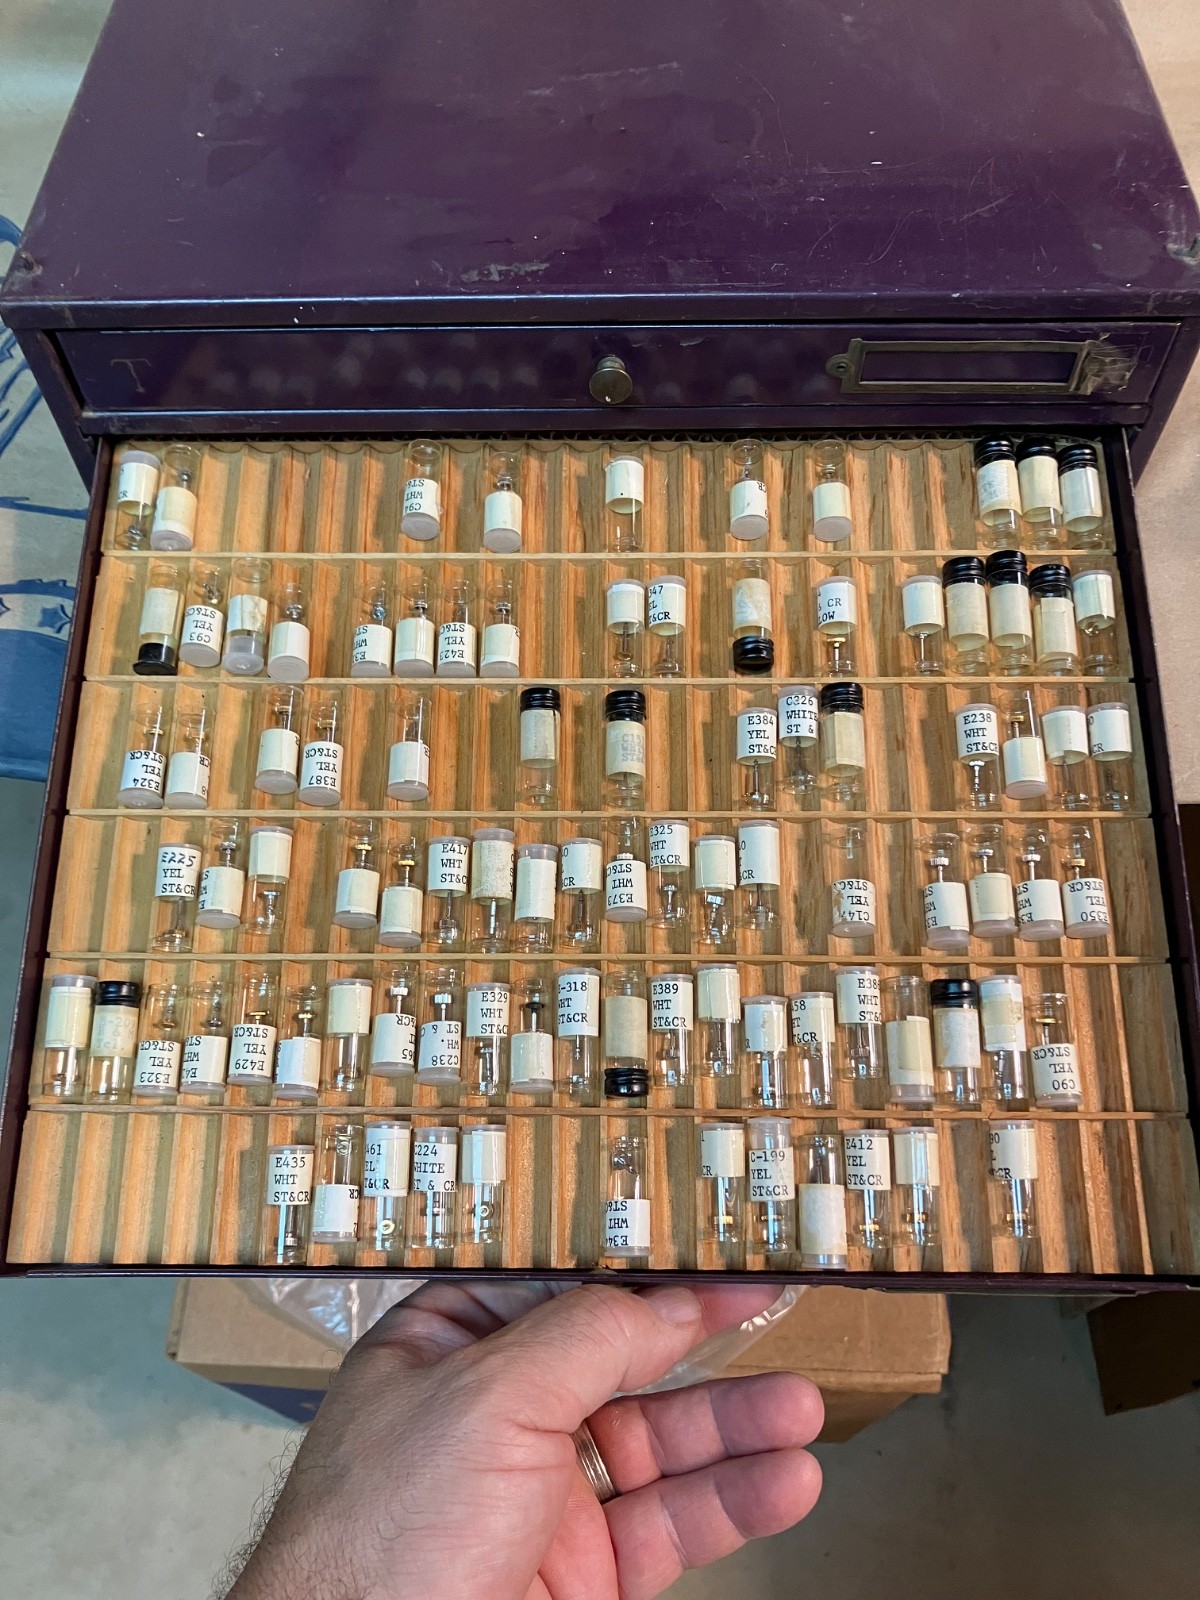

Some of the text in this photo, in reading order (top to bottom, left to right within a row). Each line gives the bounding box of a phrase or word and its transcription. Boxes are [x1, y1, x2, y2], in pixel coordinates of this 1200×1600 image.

[193, 620, 213, 631] YEL
[190, 632, 211, 643] C93
[444, 637, 465, 645] YEL
[748, 715, 774, 725] E384
[786, 710, 818, 721] WHITE
[963, 713, 992, 725] E238
[787, 724, 814, 733] ST &
[964, 728, 987, 738] WHT
[747, 730, 769, 739] YEL
[130, 751, 163, 764] ST&CR
[305, 747, 338, 758] ST&CR
[142, 764, 161, 777] YEL
[316, 762, 337, 772] YEL
[133, 778, 160, 791] E324
[308, 775, 336, 787] E387
[650, 825, 674, 836] E325
[441, 843, 468, 855] E417
[441, 859, 463, 869] WHT
[650, 855, 682, 866] ST&CR
[163, 869, 184, 878] YEL
[161, 883, 196, 895] ST&CR
[612, 878, 633, 889] WHT
[1069, 881, 1104, 893] ST&CR
[608, 893, 634, 906] E373
[847, 895, 869, 906] YEL
[653, 983, 679, 994] E389
[482, 992, 508, 1002] E329
[858, 995, 879, 1006] WHT
[653, 1000, 672, 1010] WHT
[481, 1008, 503, 1018] WHT
[653, 1017, 687, 1027] ST&CR
[234, 1027, 268, 1038] ST&CR
[432, 1025, 438, 1034] &
[447, 1024, 459, 1033] ST
[140, 1041, 174, 1051] ST&CR
[244, 1043, 266, 1055] YEL
[1033, 1047, 1071, 1060] ST&CR
[150, 1057, 172, 1068] YEL
[235, 1059, 264, 1070] E429
[431, 1055, 459, 1065] C238
[1050, 1063, 1073, 1074] YEL
[140, 1072, 170, 1083] E323
[1052, 1078, 1076, 1090] C90
[846, 1139, 873, 1150] E412
[275, 1156, 306, 1168] E435
[750, 1151, 786, 1162] C-199
[846, 1156, 867, 1167] YEL
[274, 1174, 298, 1184] WHT
[751, 1169, 772, 1180] YEL
[847, 1174, 884, 1186] ST&CR
[427, 1180, 435, 1190] &
[273, 1191, 310, 1202] ST&CR
[752, 1185, 789, 1197] ST&CR
[608, 1218, 629, 1229] WHT
